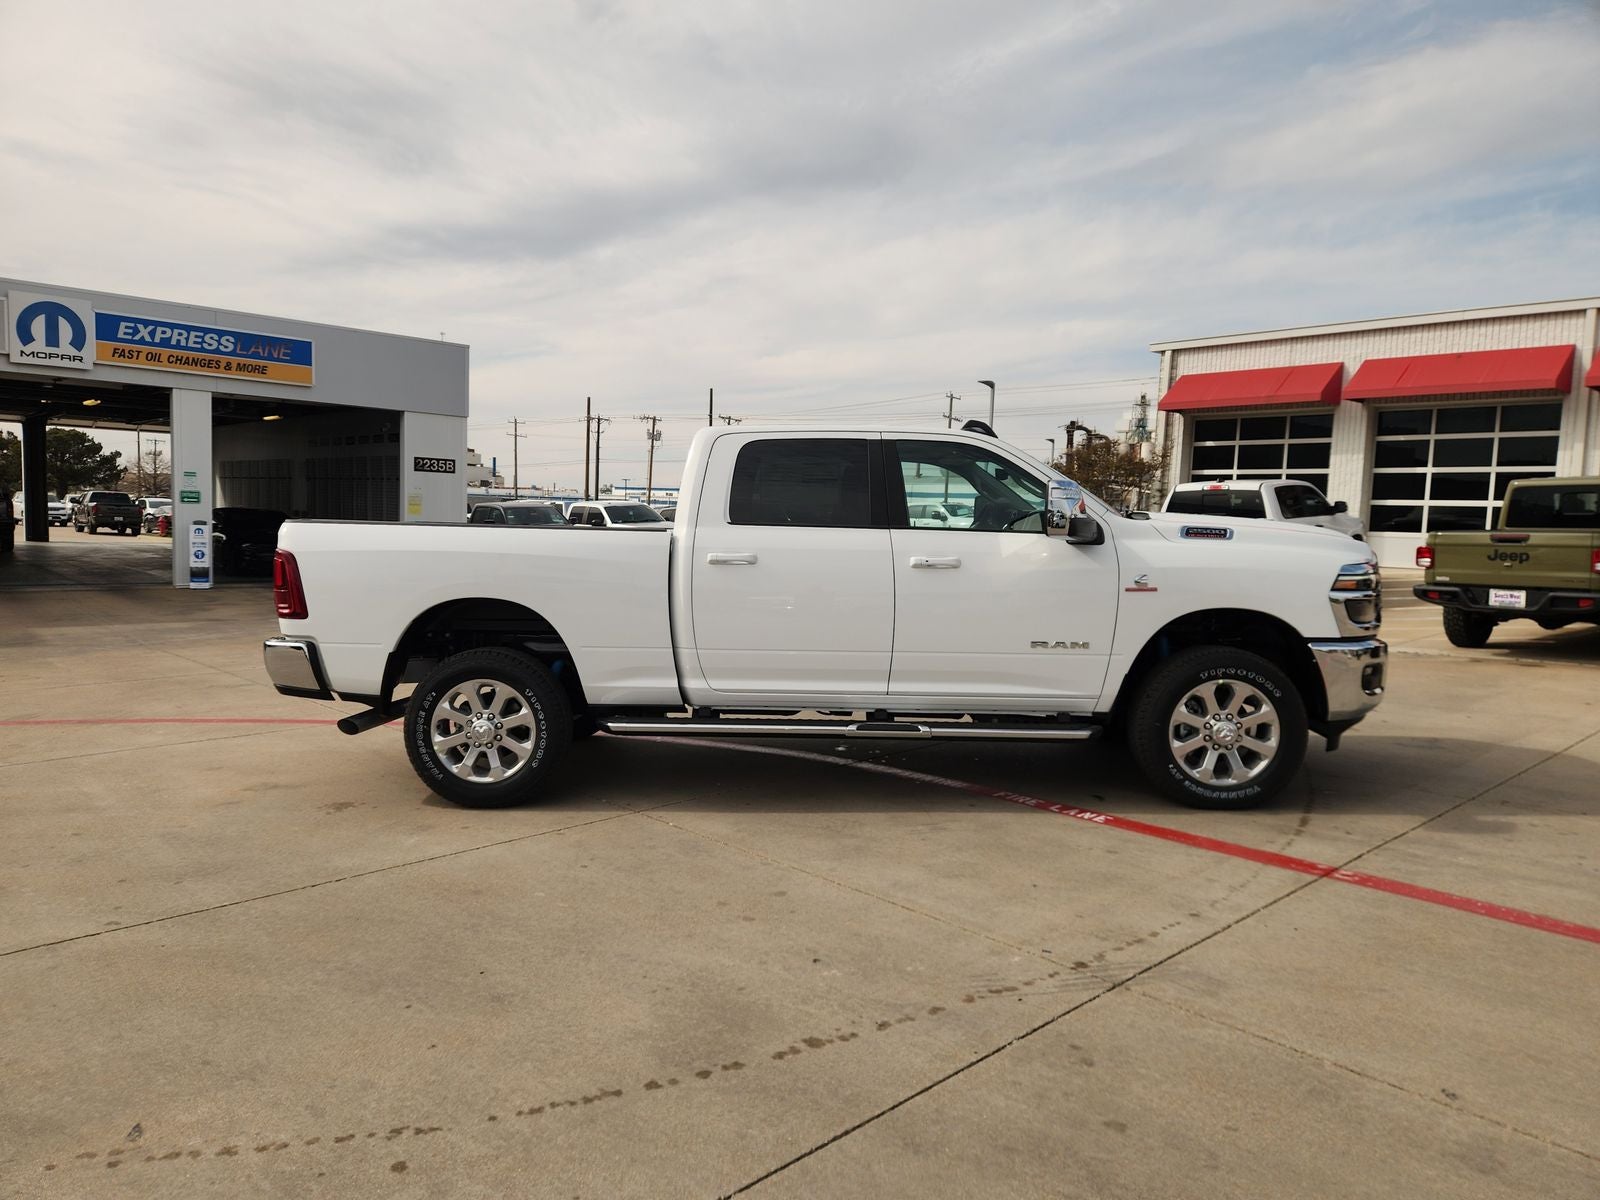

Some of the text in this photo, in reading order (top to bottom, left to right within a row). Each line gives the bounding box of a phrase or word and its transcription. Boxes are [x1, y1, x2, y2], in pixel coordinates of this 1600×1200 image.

[20, 350, 84, 363] MOPAR
[111, 348, 269, 375] FAST OIL CHANGES & MORE
[415, 458, 454, 472] 2235B
[1487, 549, 1530, 564] Jeep
[1030, 641, 1089, 649] RAM
[992, 791, 1114, 823] FIRE LANE
